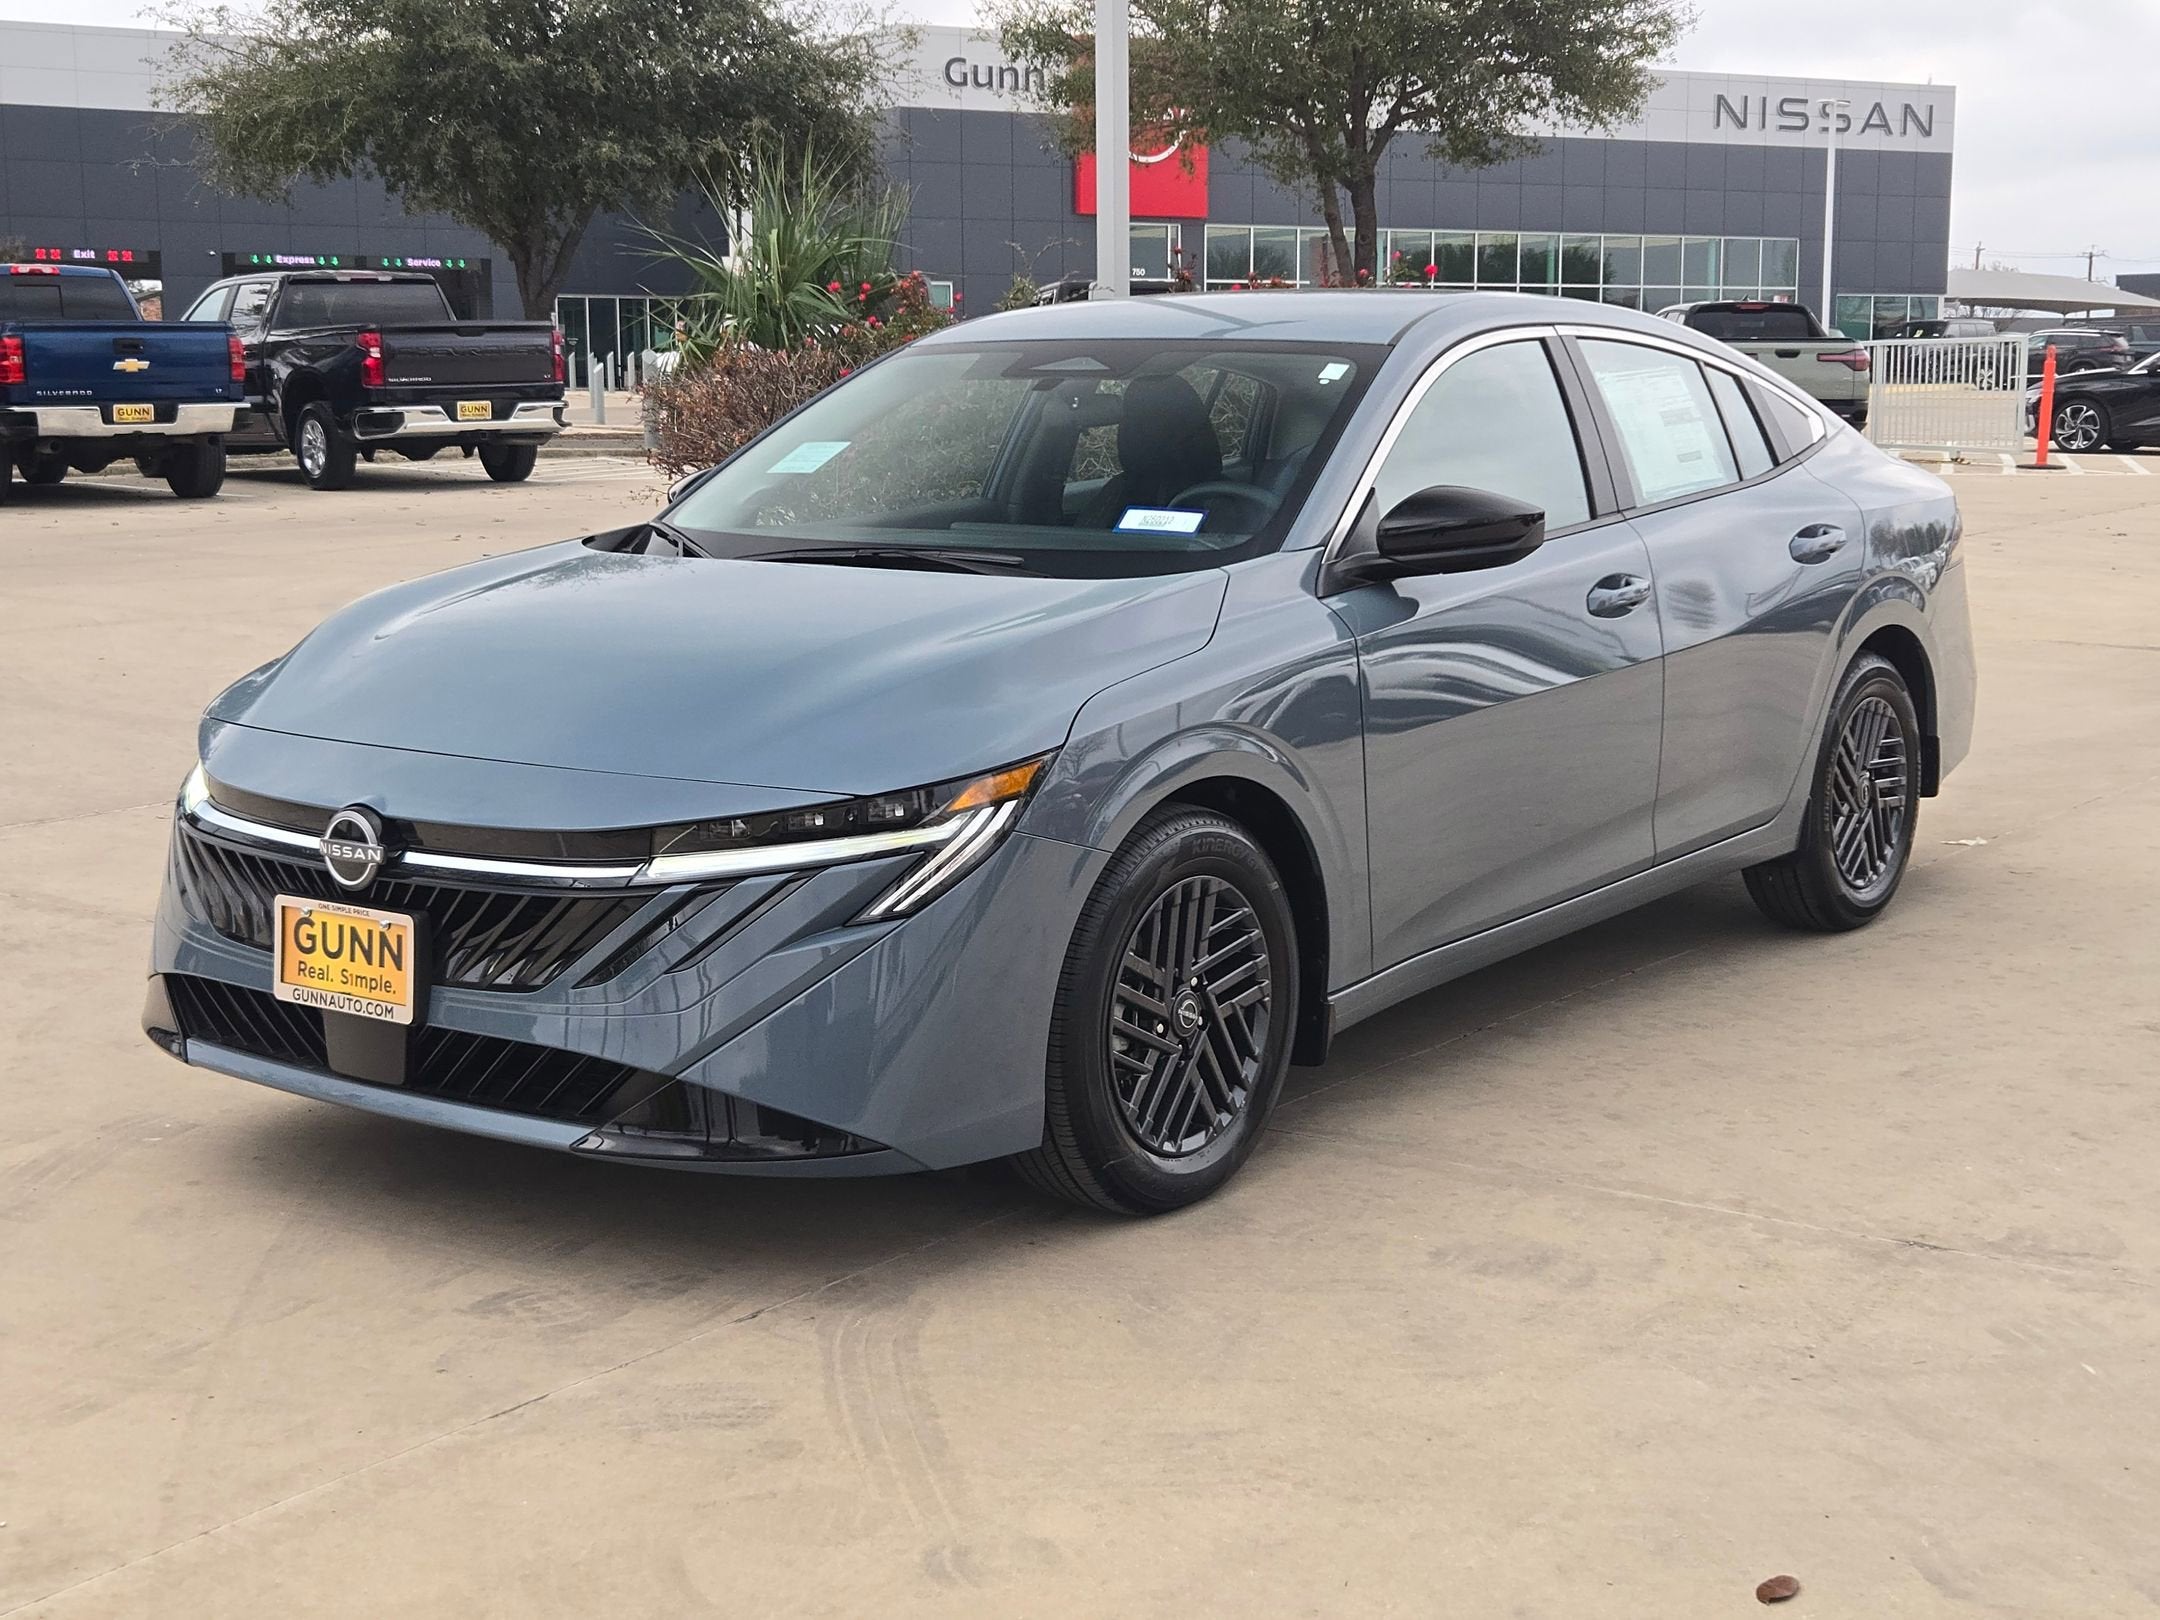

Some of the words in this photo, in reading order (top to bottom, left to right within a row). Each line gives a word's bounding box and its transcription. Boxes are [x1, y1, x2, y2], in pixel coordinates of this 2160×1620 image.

[944, 57, 1045, 91] Gunn
[1714, 94, 1934, 137] NISSAN
[73, 249, 95, 259] Exit
[275, 254, 315, 265] Express
[406, 258, 441, 267] Service
[1132, 268, 1145, 276] 750
[117, 408, 150, 416] GUNN
[461, 405, 487, 413] GUNN
[320, 842, 381, 861] NISSAN
[318, 903, 330, 911] ONE
[331, 904, 352, 914] SIMPLE
[352, 908, 370, 917] PRICE
[293, 916, 403, 971] GUNN
[297, 960, 334, 982] Real.
[292, 987, 394, 1019] GUNNAUTO.COM
